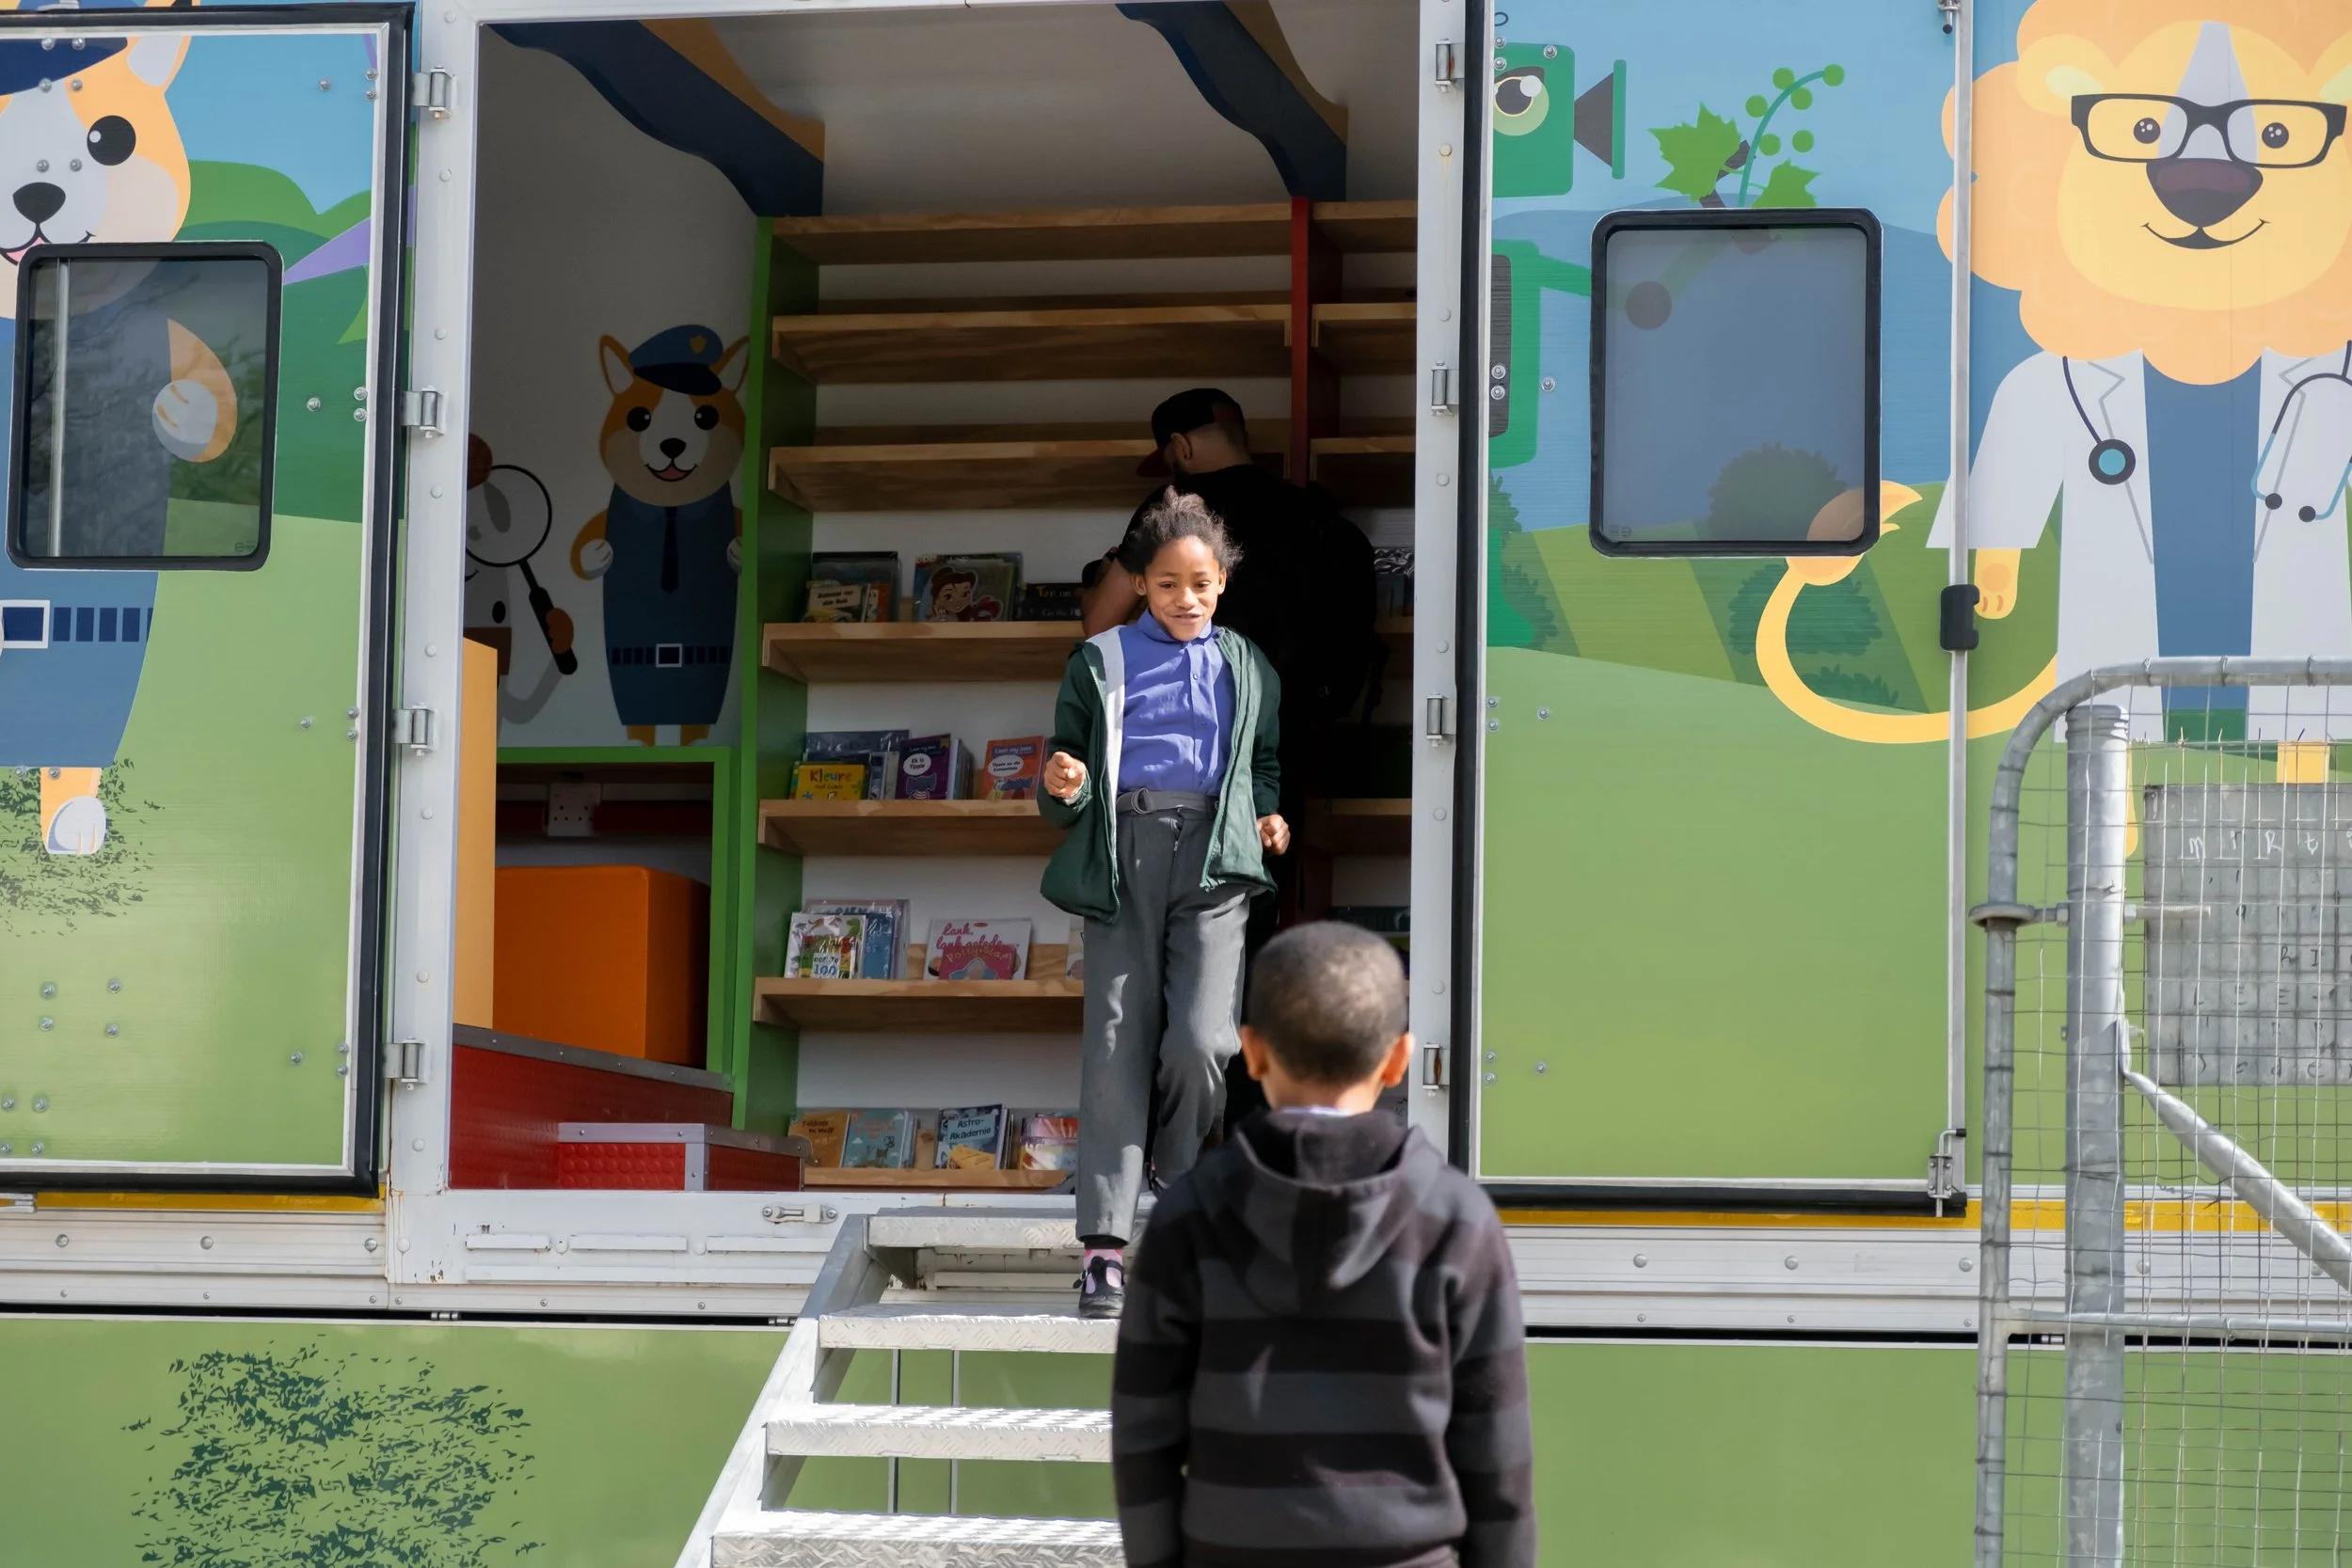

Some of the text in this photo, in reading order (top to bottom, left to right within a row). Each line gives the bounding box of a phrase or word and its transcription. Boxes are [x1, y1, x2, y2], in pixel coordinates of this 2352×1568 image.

[809, 767, 852, 783] Kleure
[813, 964, 837, 976] 100
[958, 1118, 985, 1129] Astro-
[949, 1127, 992, 1140] Akademie
